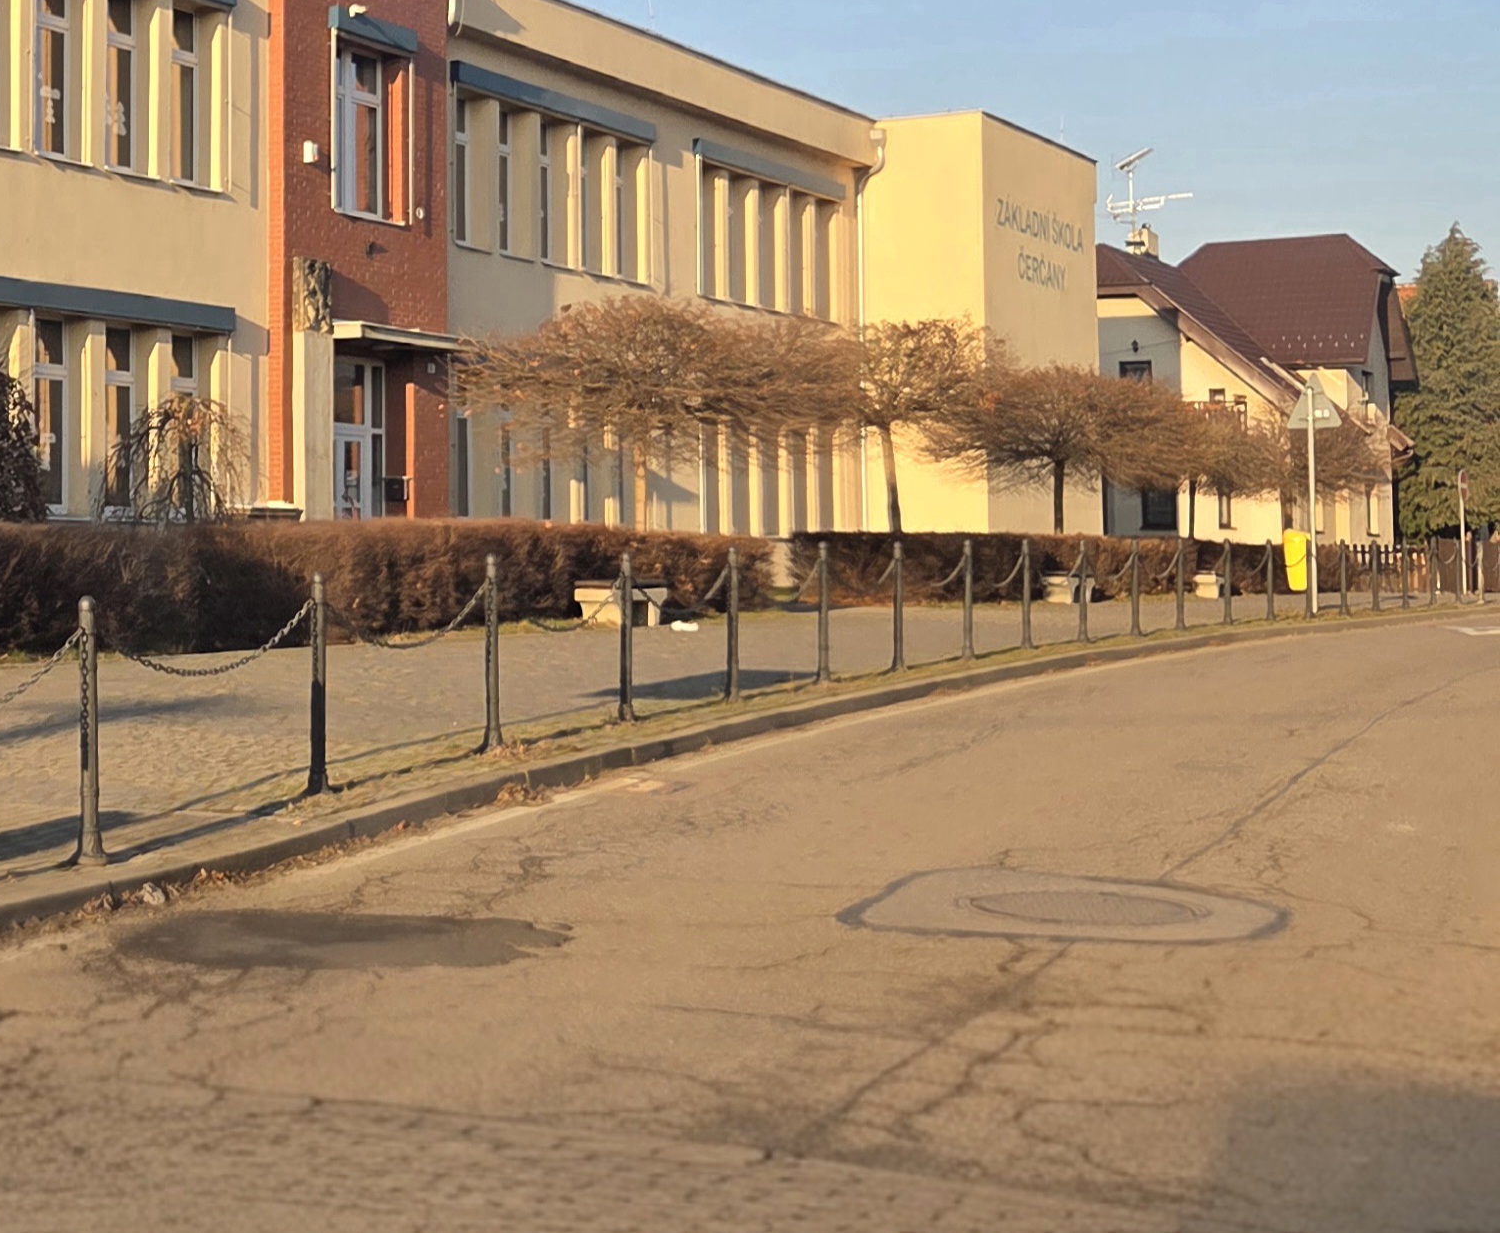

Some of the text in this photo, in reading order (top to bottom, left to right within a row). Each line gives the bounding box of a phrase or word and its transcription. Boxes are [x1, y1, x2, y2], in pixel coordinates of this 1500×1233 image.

[997, 193, 1084, 255] ZÁKLADNÍ ŠKOLA
[1017, 245, 1066, 292] ČERČANY
